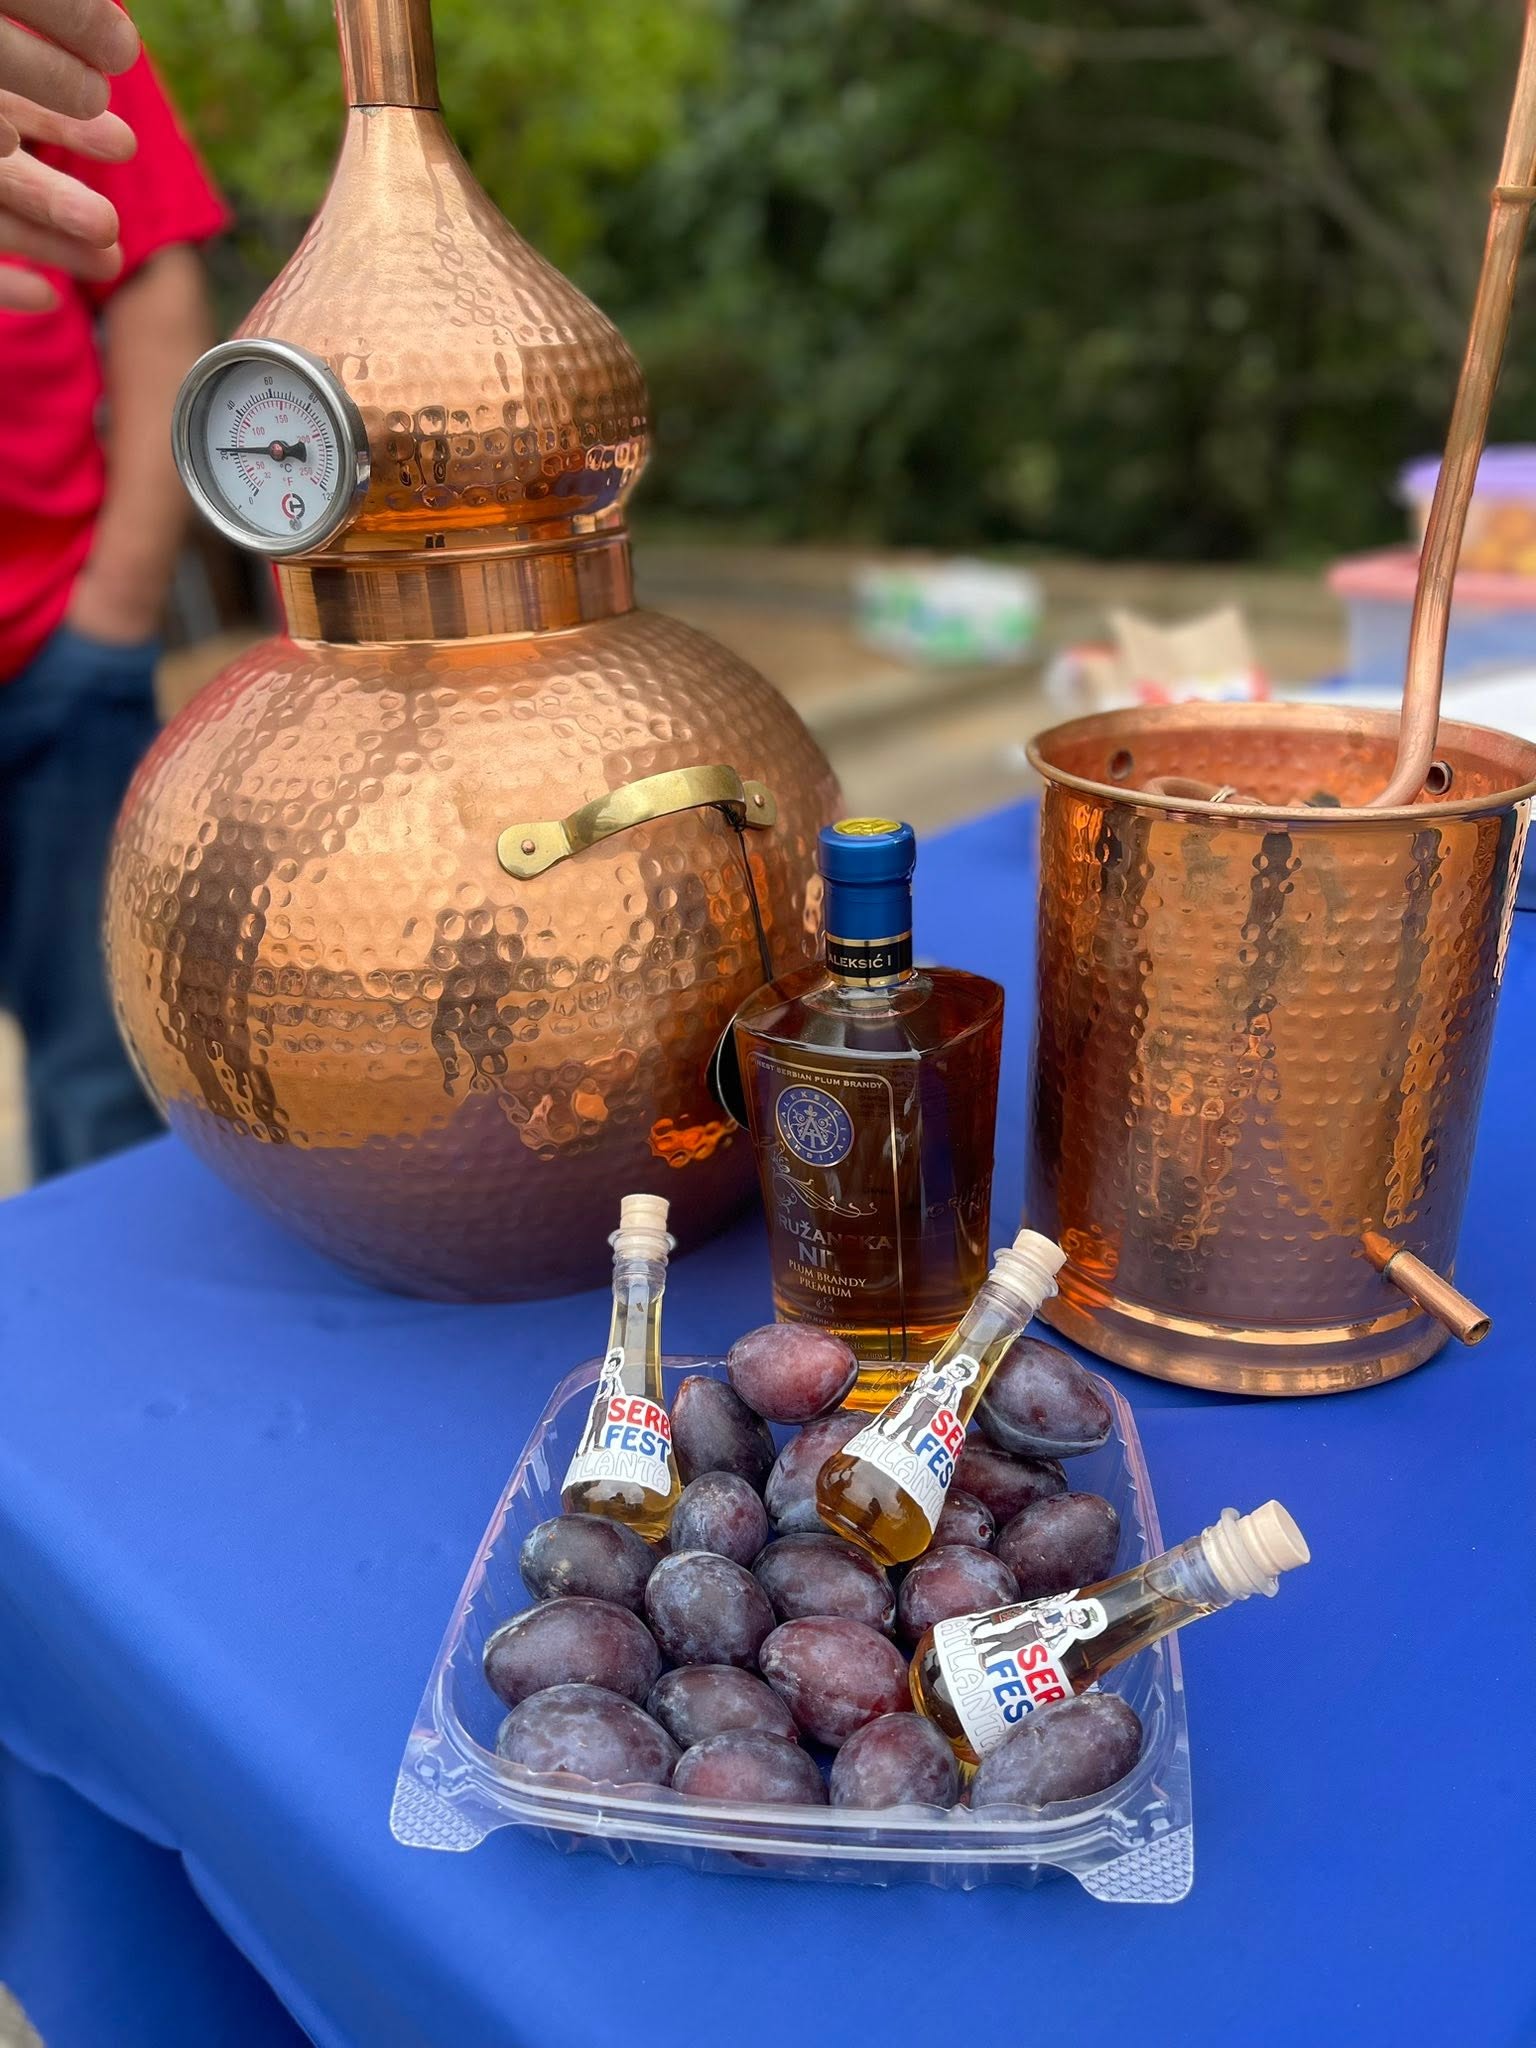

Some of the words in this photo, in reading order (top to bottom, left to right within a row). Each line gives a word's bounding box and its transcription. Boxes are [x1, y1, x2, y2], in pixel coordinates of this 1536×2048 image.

[264, 377, 273, 386] 60
[227, 401, 235, 411] 40
[275, 415, 288, 424] 150
[252, 427, 265, 436] 100
[221, 450, 229, 460] 20
[256, 461, 265, 470] 50
[299, 467, 313, 476] 250
[264, 471, 271, 479] 32
[828, 953, 883, 969] ALEKSIĆ
[777, 1068, 812, 1082] SERBIAN
[814, 1076, 840, 1086] PLUM
[843, 1081, 883, 1089] BRANDY
[778, 1213, 893, 1250] RUŽANKA
[788, 1259, 814, 1279] PLUM
[817, 1270, 867, 1288] BRANDY
[800, 1276, 852, 1298] PREMIUM
[608, 1397, 671, 1441] SERB
[604, 1425, 670, 1463] FEST
[914, 1433, 954, 1489] FES
[569, 1450, 670, 1491] TLANTA
[986, 1659, 1034, 1723] FES
